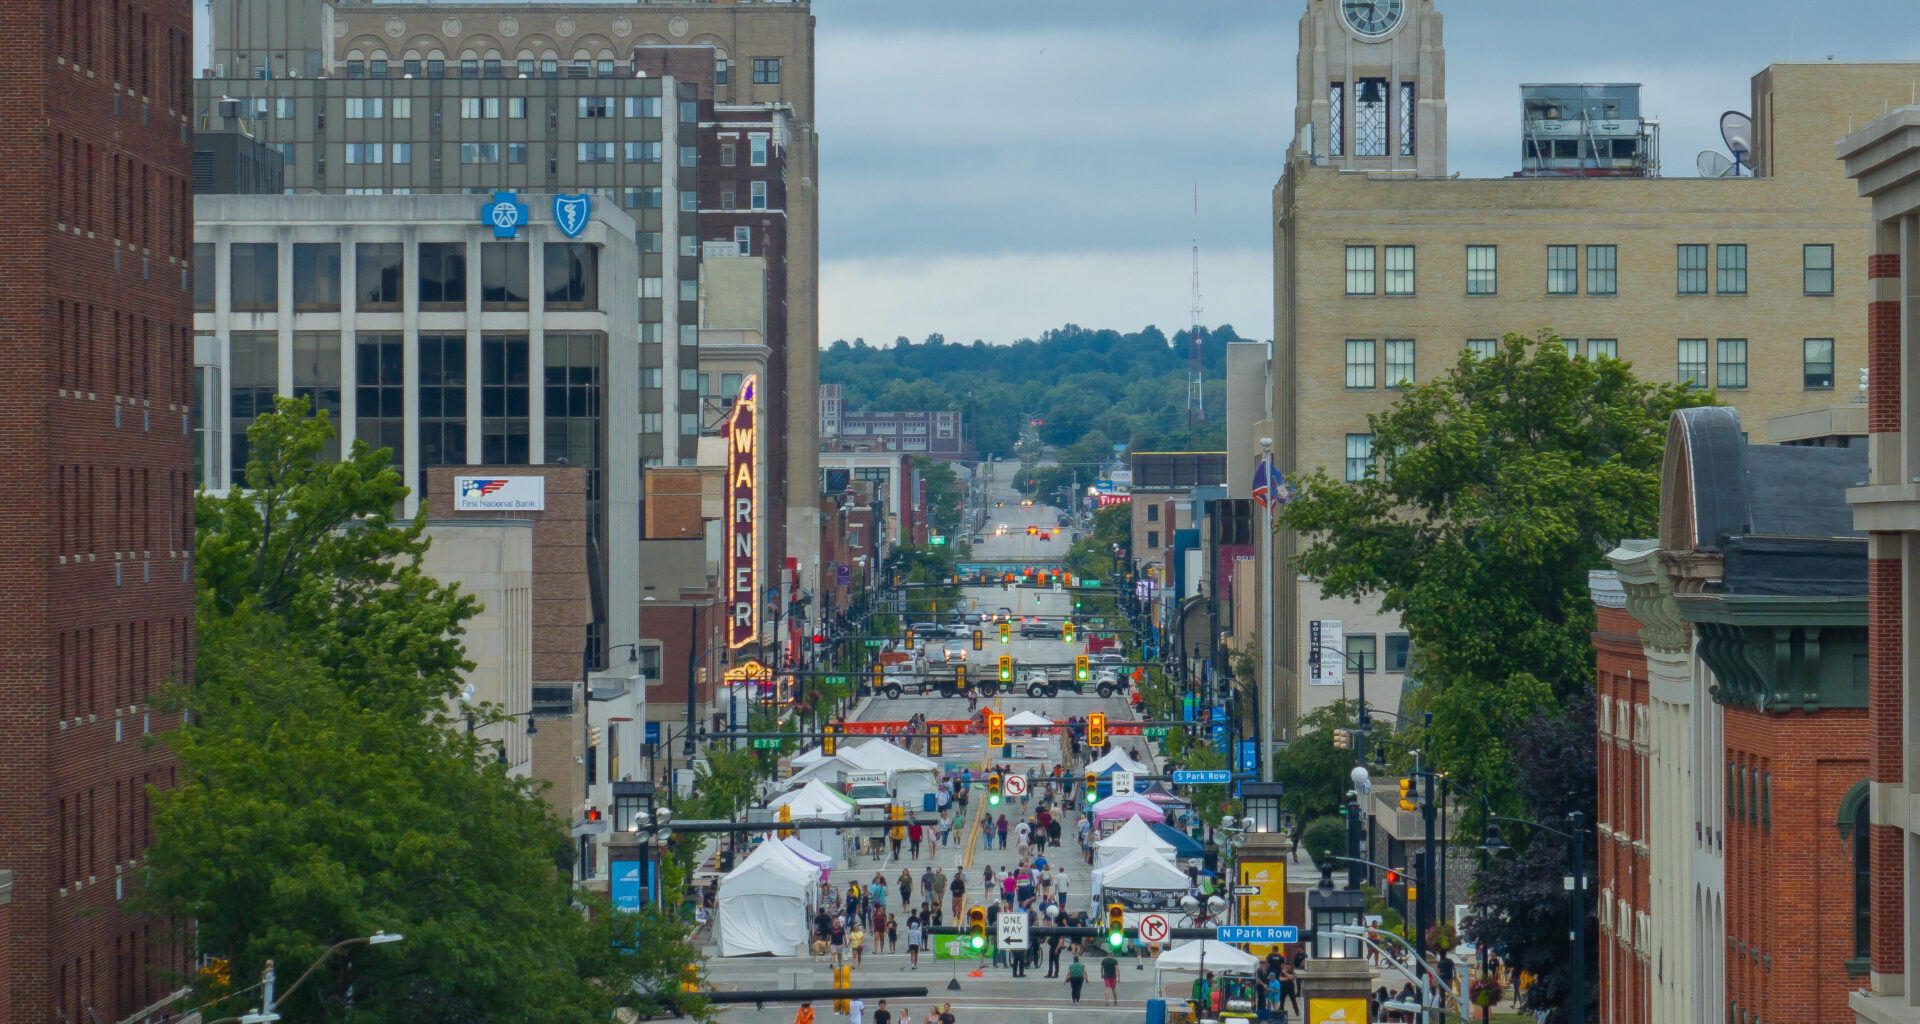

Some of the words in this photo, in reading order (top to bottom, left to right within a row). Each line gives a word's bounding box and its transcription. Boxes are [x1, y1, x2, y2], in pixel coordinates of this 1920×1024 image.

[462, 500, 478, 508] First
[480, 500, 513, 508] National
[515, 500, 536, 508] Bank
[735, 428, 752, 627] WARNER
[1003, 916, 1022, 924] ONE
[1003, 926, 1022, 934] WAY
[1223, 929, 1231, 938] N
[1236, 928, 1262, 938] Park
[1268, 929, 1292, 938] Row
